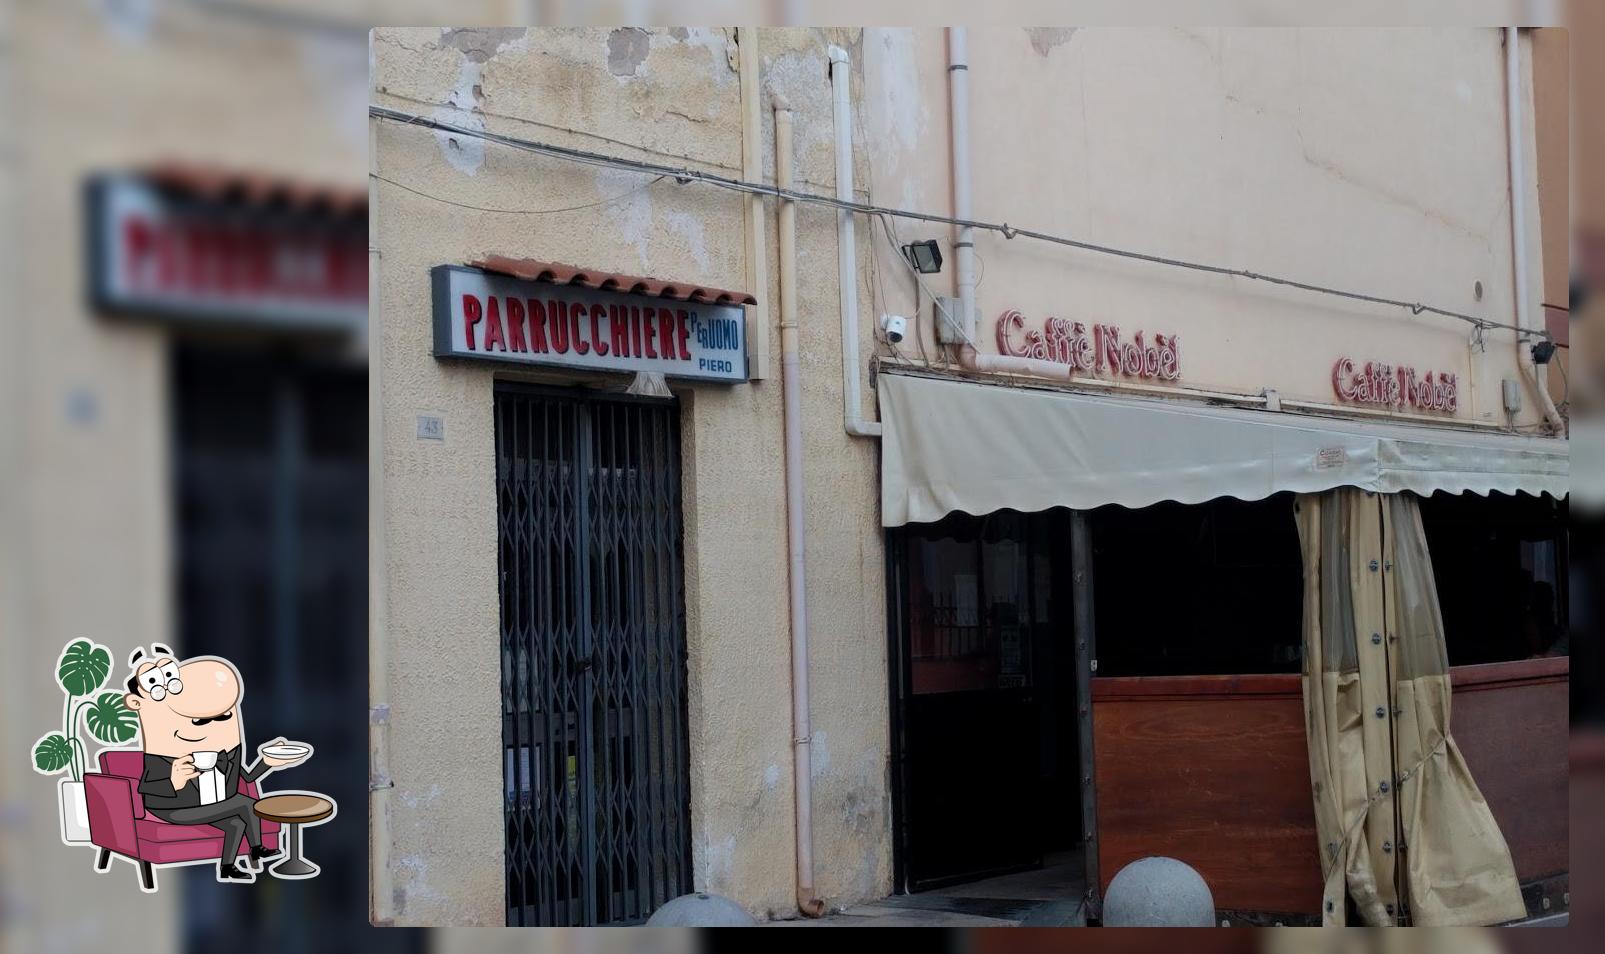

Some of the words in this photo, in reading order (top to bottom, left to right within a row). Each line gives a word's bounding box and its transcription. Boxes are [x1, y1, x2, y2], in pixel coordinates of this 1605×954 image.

[462, 294, 692, 361] PARRUCCHIERE
[690, 311, 709, 350] PER
[708, 319, 739, 351] UOMO
[699, 358, 732, 373] PIERO
[423, 420, 439, 434] 43
